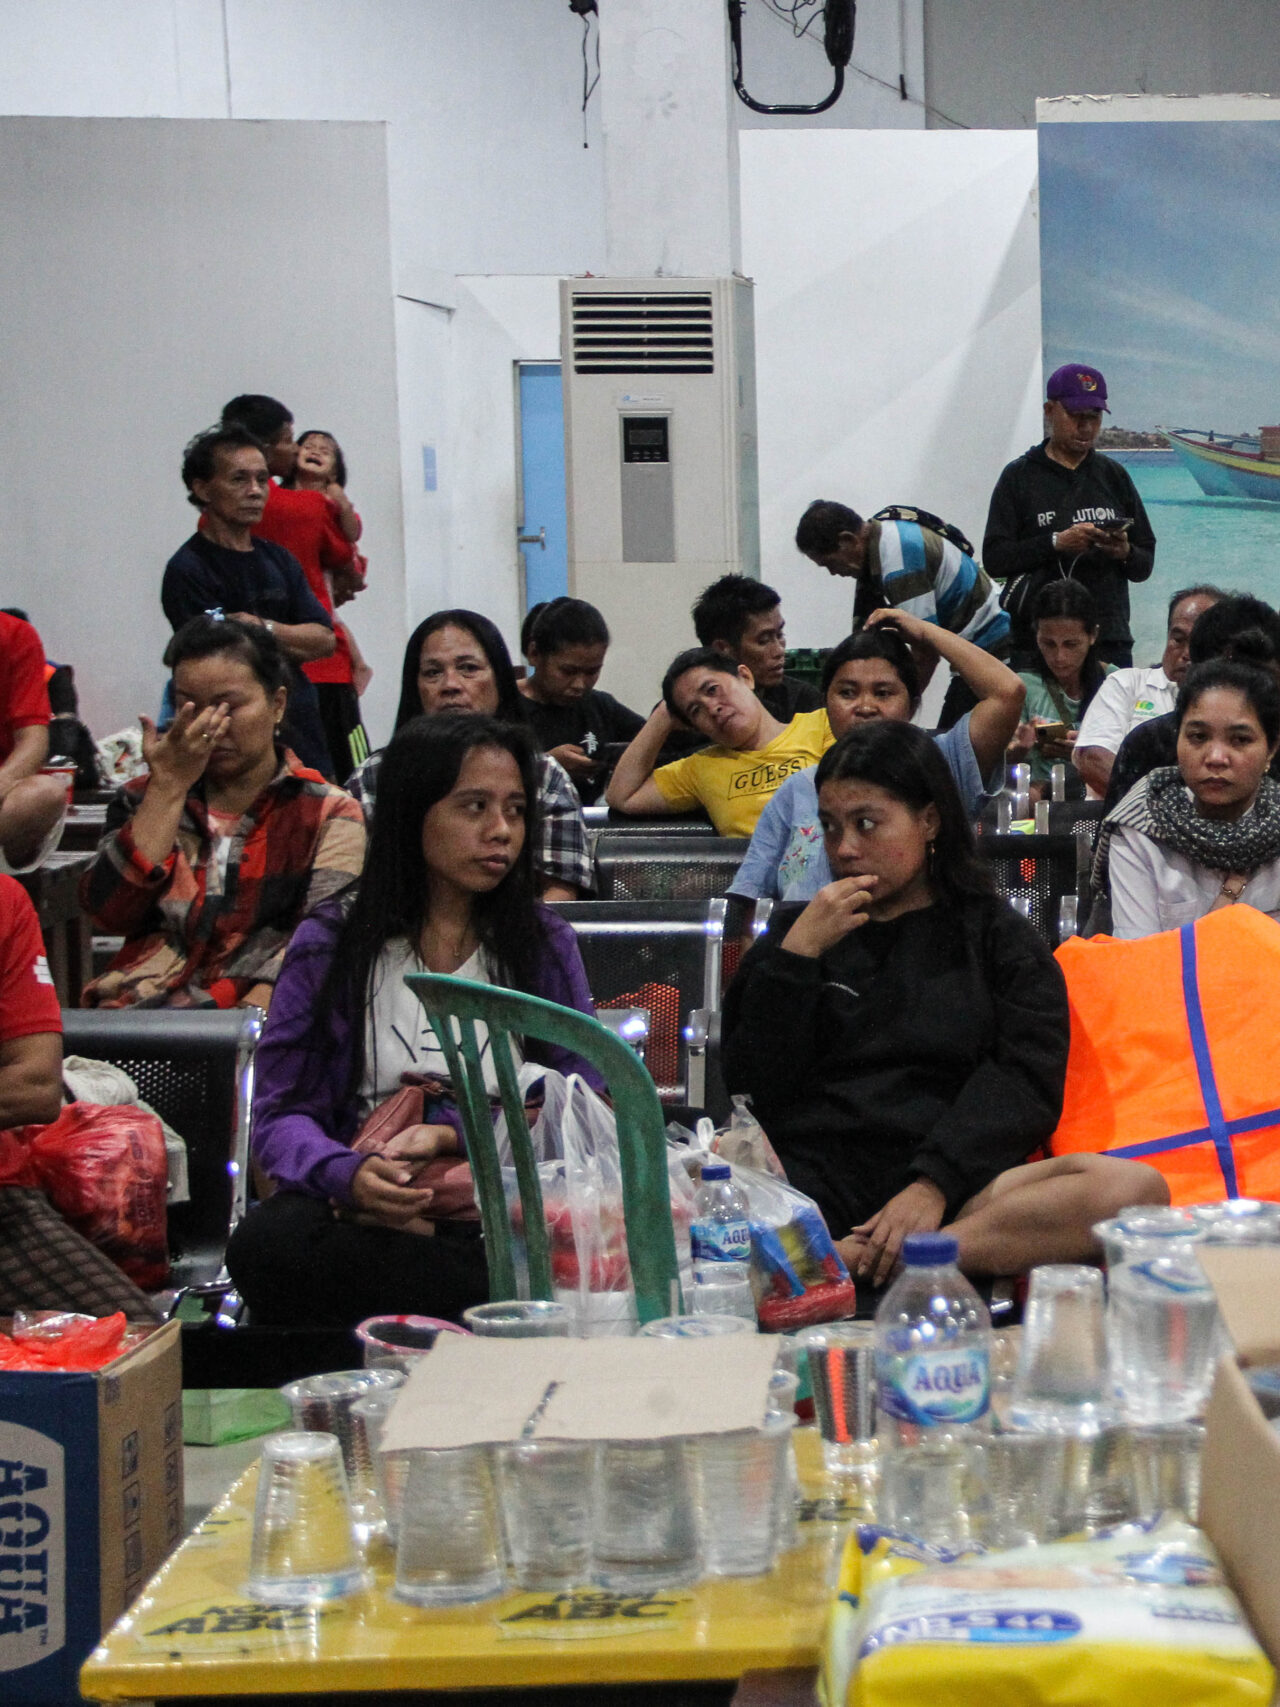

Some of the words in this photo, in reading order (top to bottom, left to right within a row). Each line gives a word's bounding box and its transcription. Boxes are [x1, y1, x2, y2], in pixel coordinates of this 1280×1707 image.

[735, 760, 802, 789] GUESS
[723, 1228, 750, 1245] AQU
[913, 1361, 981, 1394] AQUA
[0, 1460, 50, 1634] AQUA
[499, 1600, 678, 1622] ABC
